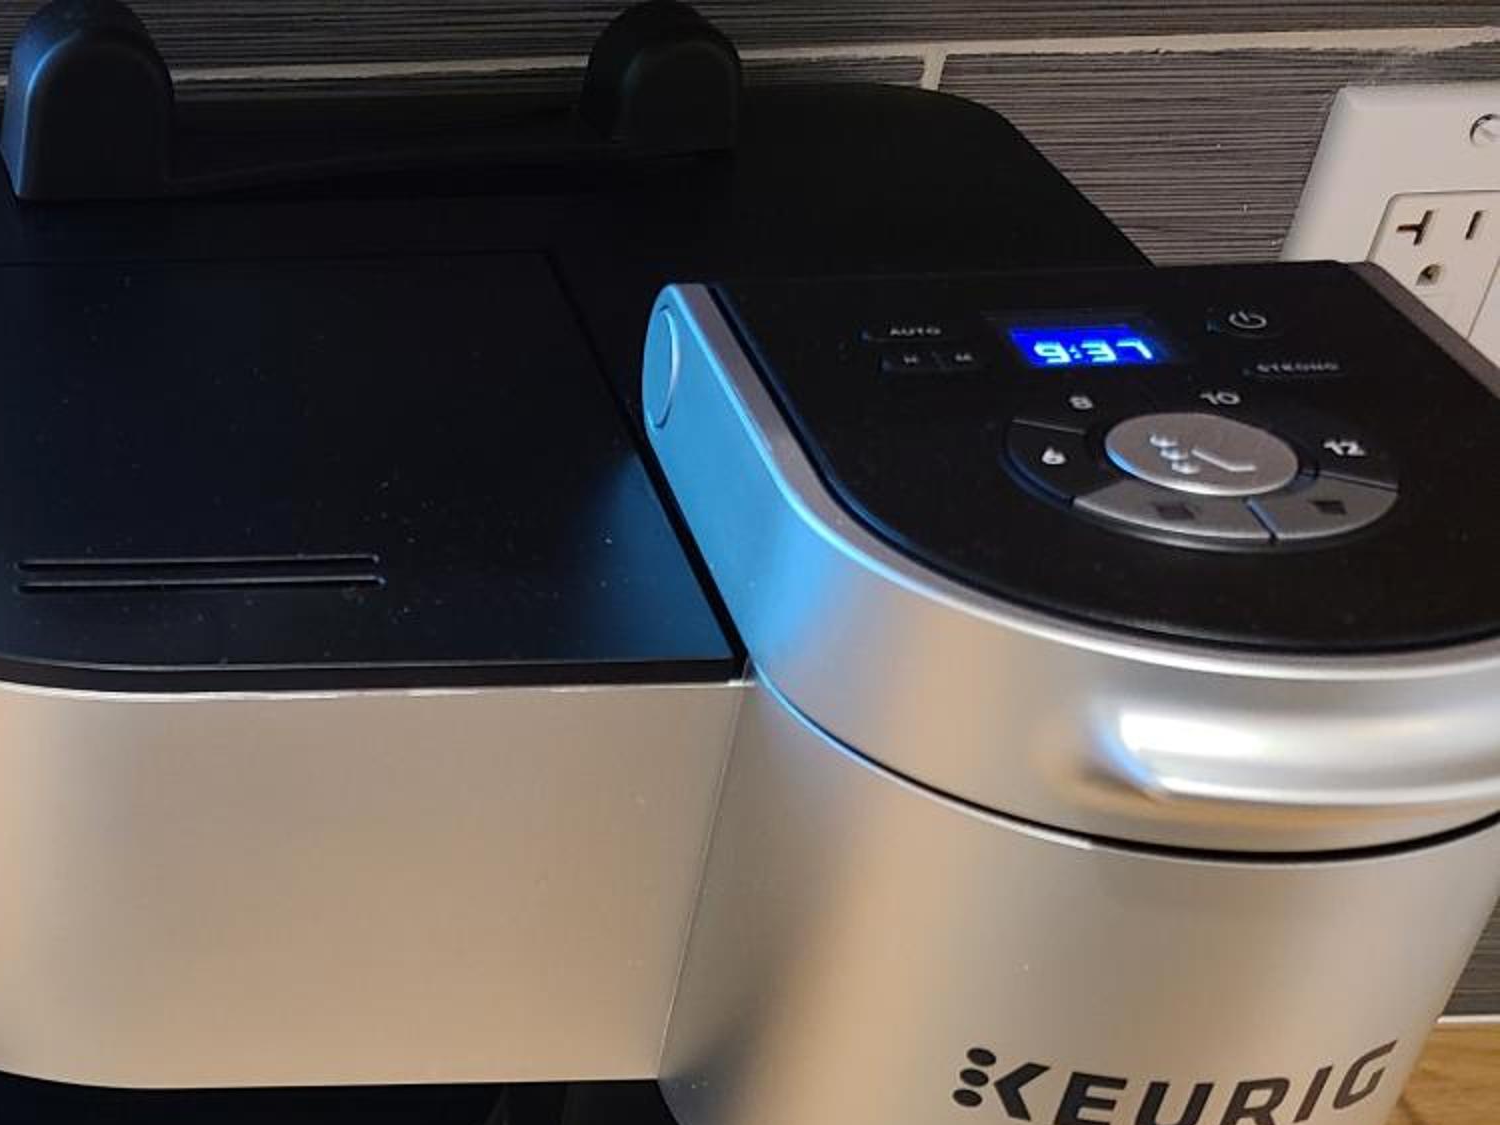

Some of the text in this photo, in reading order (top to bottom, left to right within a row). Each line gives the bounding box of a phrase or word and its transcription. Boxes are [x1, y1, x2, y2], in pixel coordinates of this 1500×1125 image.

[1033, 337, 1154, 364] 9:37
[1069, 396, 1093, 410] 8
[1200, 391, 1241, 405] 10
[1042, 447, 1067, 465] 6
[1324, 439, 1367, 456] 12
